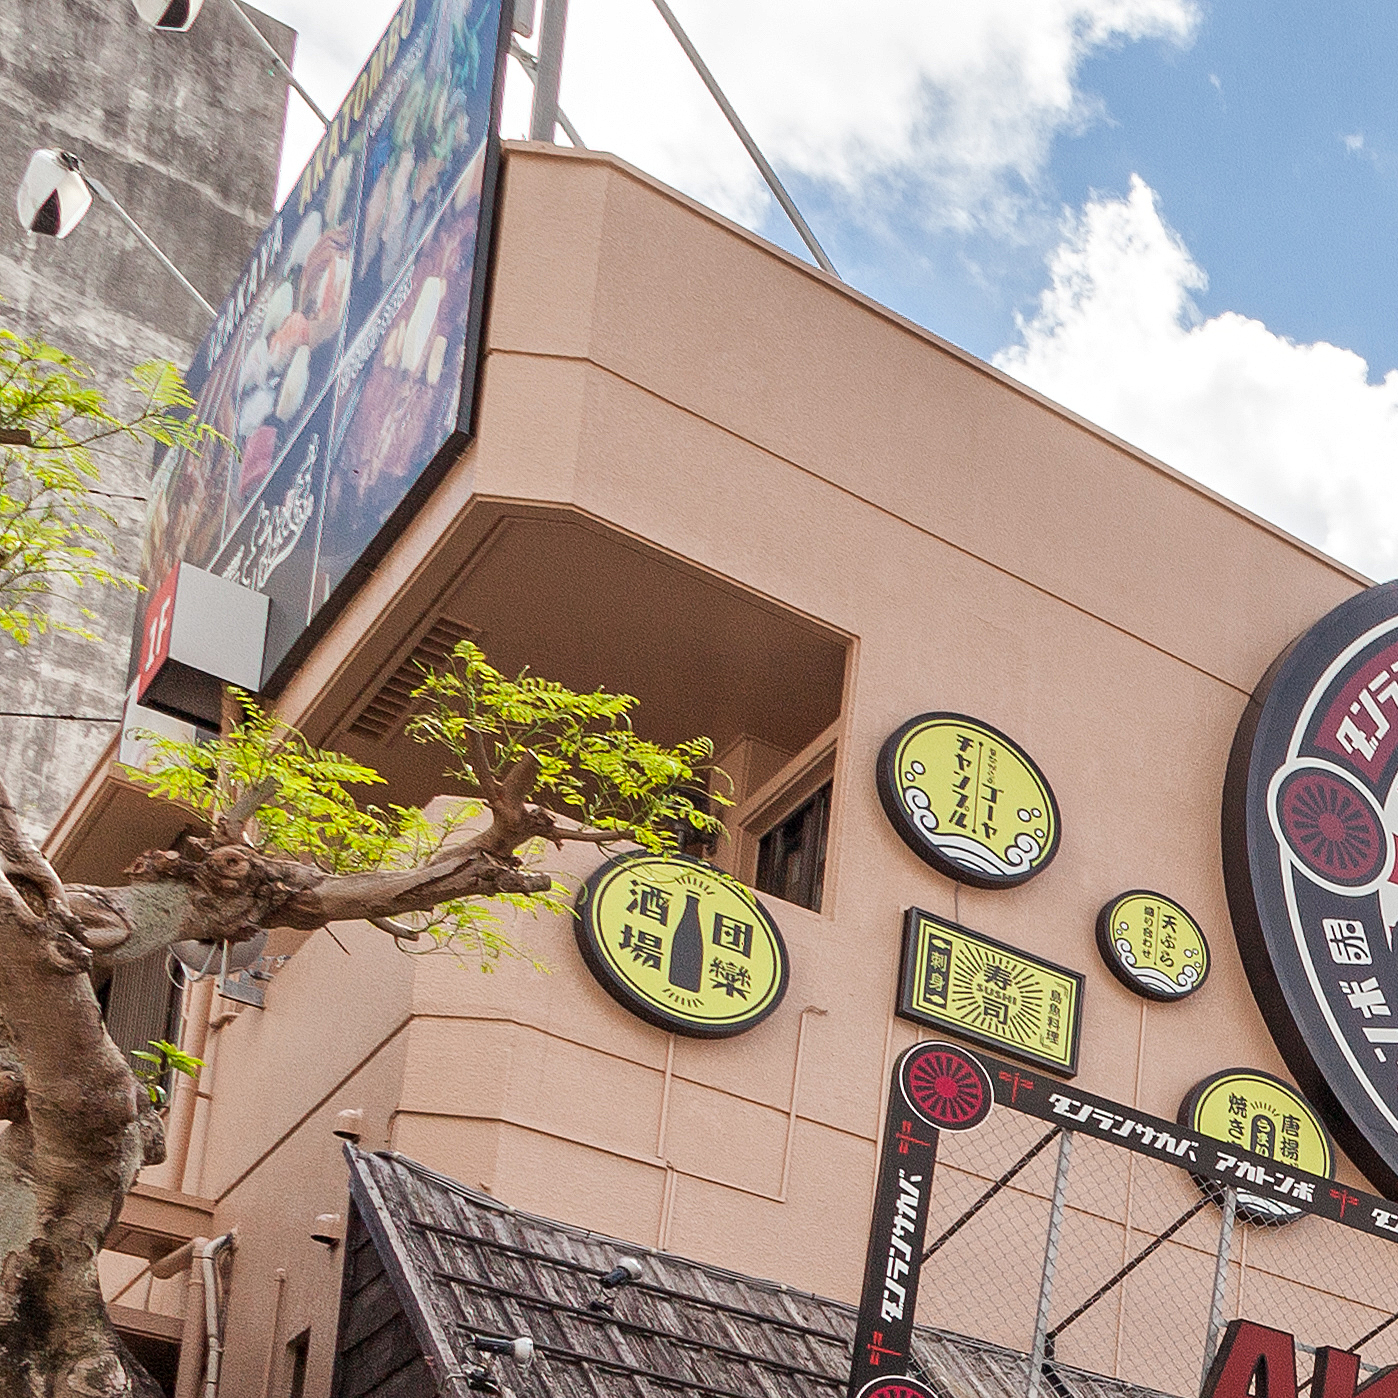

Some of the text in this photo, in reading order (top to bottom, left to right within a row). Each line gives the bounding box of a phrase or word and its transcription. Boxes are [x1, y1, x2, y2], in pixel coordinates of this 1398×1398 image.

[619, 878, 673, 972] 酒場
[1160, 914, 1178, 968] 天ぷら
[929, 950, 947, 996] 刺身
[975, 982, 1018, 1006] SUSHI
[1048, 1093, 1316, 1203] ダンランサカバ アカトンボ
[880, 1168, 923, 1323] ダンランサカバ
